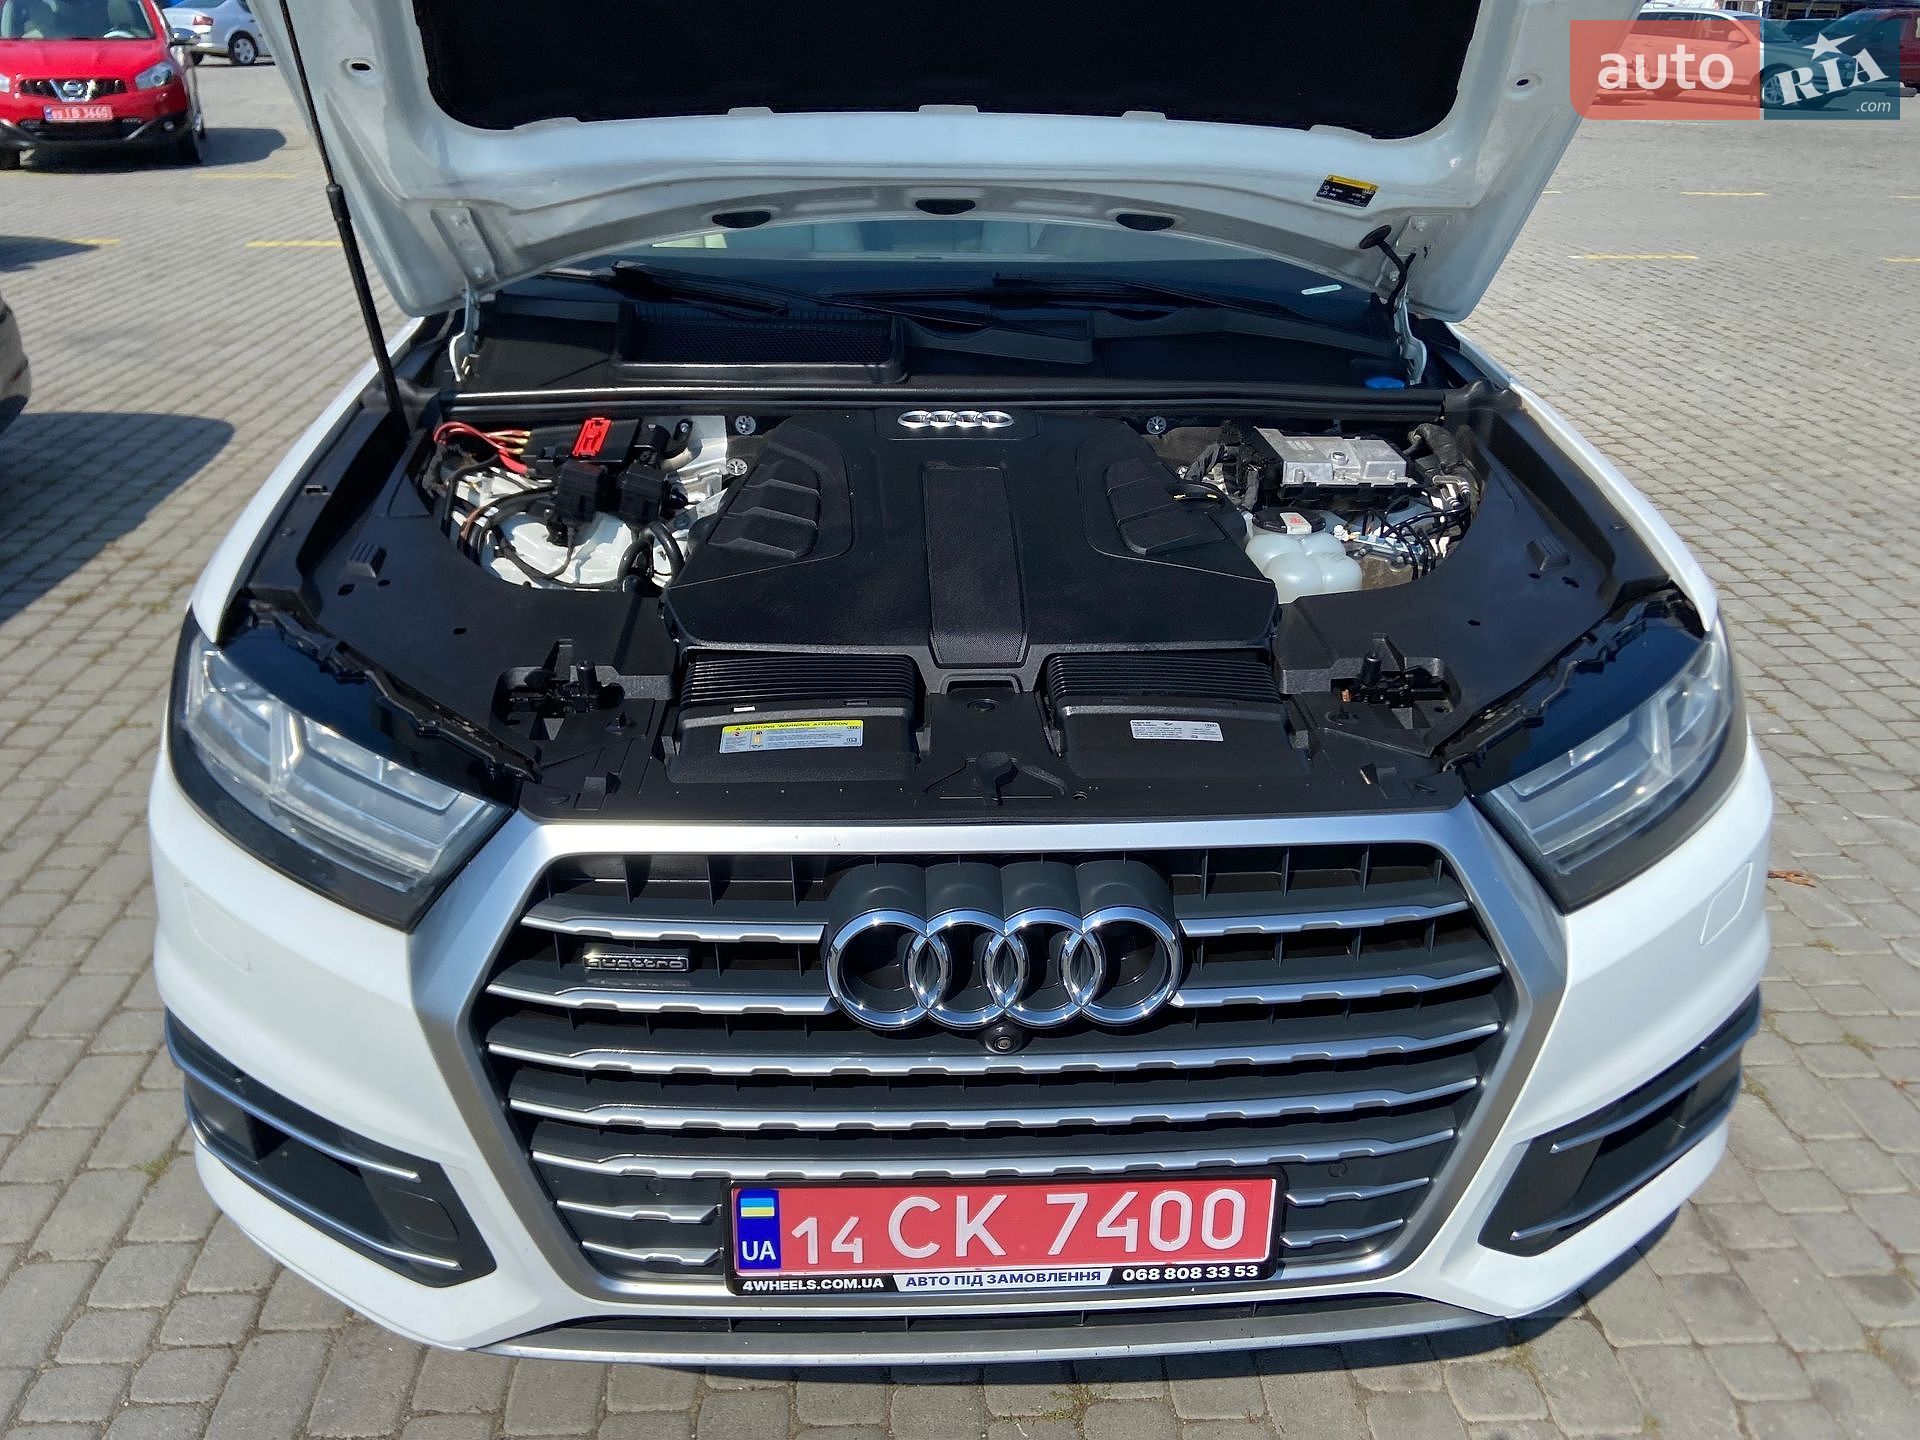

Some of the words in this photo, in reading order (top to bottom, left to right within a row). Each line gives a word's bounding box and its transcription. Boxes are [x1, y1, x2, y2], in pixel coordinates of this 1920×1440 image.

[588, 958, 683, 969] quattro
[791, 1216, 863, 1265] 14
[888, 1195, 1007, 1259] CK
[1046, 1188, 1246, 1256] 7400
[741, 1240, 777, 1261] UA
[905, 1275, 950, 1287] АВТО
[954, 1274, 983, 1287] ПІД
[986, 1271, 1101, 1285] ЗАМОВЛЕННЯ
[1122, 1268, 1160, 1281] 068
[1164, 1267, 1202, 1280] 808
[1205, 1266, 1230, 1279] 33
[1234, 1265, 1258, 1278] 53
[742, 1277, 884, 1291] 4WHEELS.COM.UA
